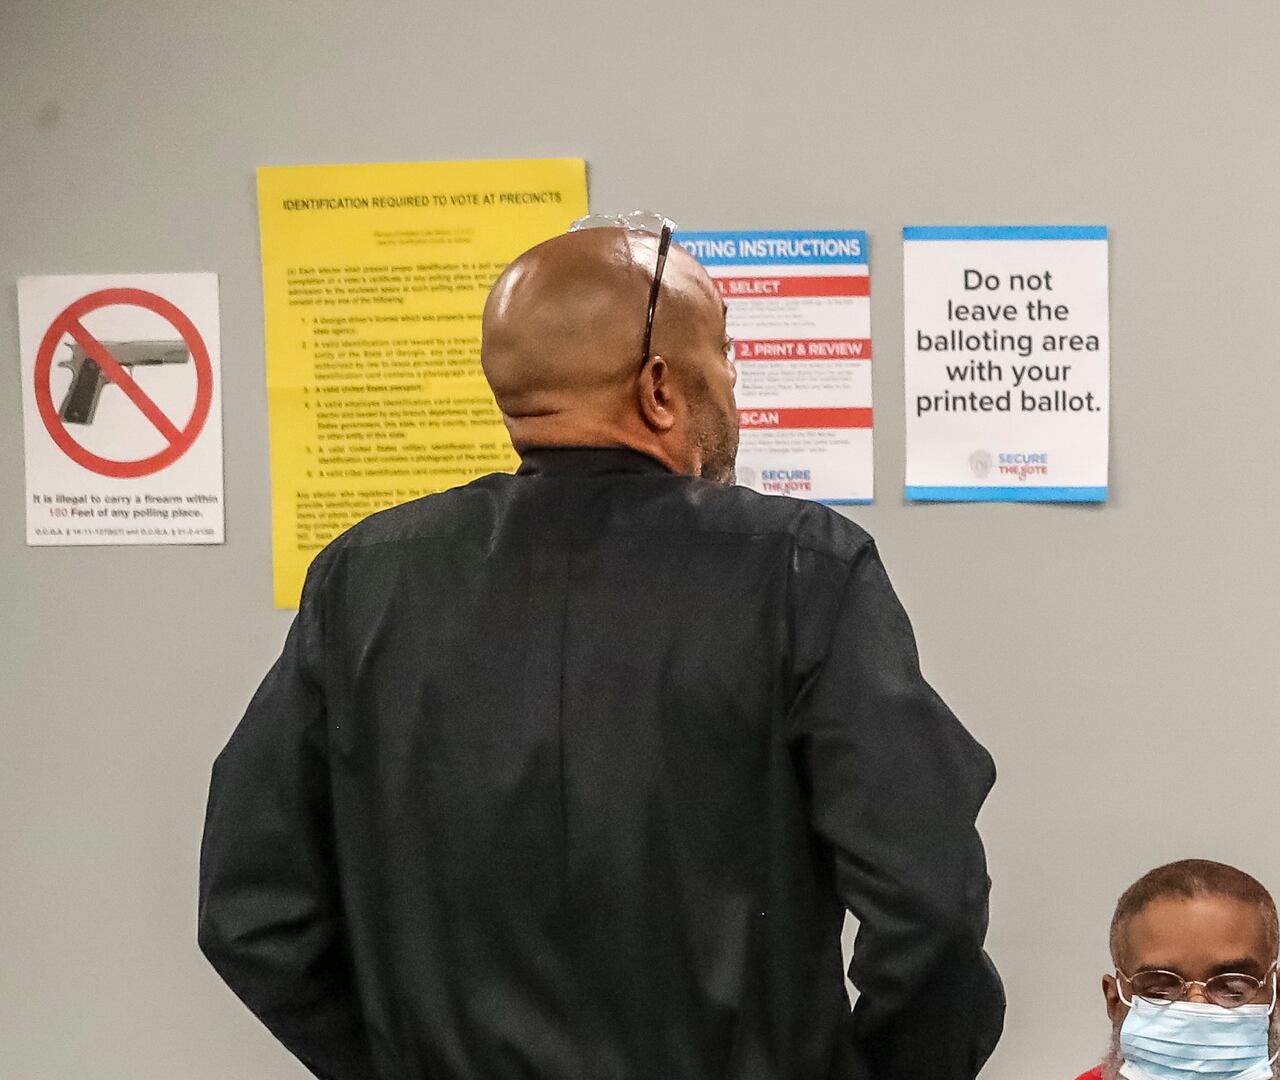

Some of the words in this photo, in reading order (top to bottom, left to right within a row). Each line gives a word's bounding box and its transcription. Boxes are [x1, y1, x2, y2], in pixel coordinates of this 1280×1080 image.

[283, 197, 368, 211] IDENTIFICATION
[373, 196, 429, 208] REQUIRED
[434, 195, 447, 206] TO
[451, 194, 477, 206] VOTE
[484, 194, 495, 204] AT
[501, 192, 562, 204] PRECINCTS
[681, 240, 737, 257] OTING
[740, 239, 861, 257] INSTRUCTIONS
[730, 281, 781, 294] SELECT
[964, 269, 1000, 291] Do
[1010, 271, 1053, 291] not
[948, 300, 1017, 321] leave
[1026, 300, 1069, 321] the
[741, 344, 751, 356] 2.
[753, 343, 795, 356] PRINT
[796, 343, 806, 356] &
[808, 342, 862, 355] REVIEW
[917, 330, 1032, 357] balloting
[1042, 335, 1099, 351] area
[946, 360, 1002, 381] with
[1012, 365, 1072, 387] your
[916, 390, 1010, 417] printed
[1022, 390, 1100, 411] ballot.
[740, 411, 780, 426] SCAN
[998, 454, 1048, 464] SECURE
[761, 470, 811, 480] SECURE
[998, 465, 1016, 474] THE
[33, 494, 40, 504] It
[43, 495, 52, 503] is
[56, 495, 87, 505] illegal
[91, 495, 101, 503] to
[104, 496, 130, 505] carry
[145, 495, 182, 503] firearm
[186, 495, 218, 503] within
[70, 507, 94, 517] Feet
[97, 508, 108, 517] of
[111, 510, 130, 519] any
[133, 508, 168, 520] polling
